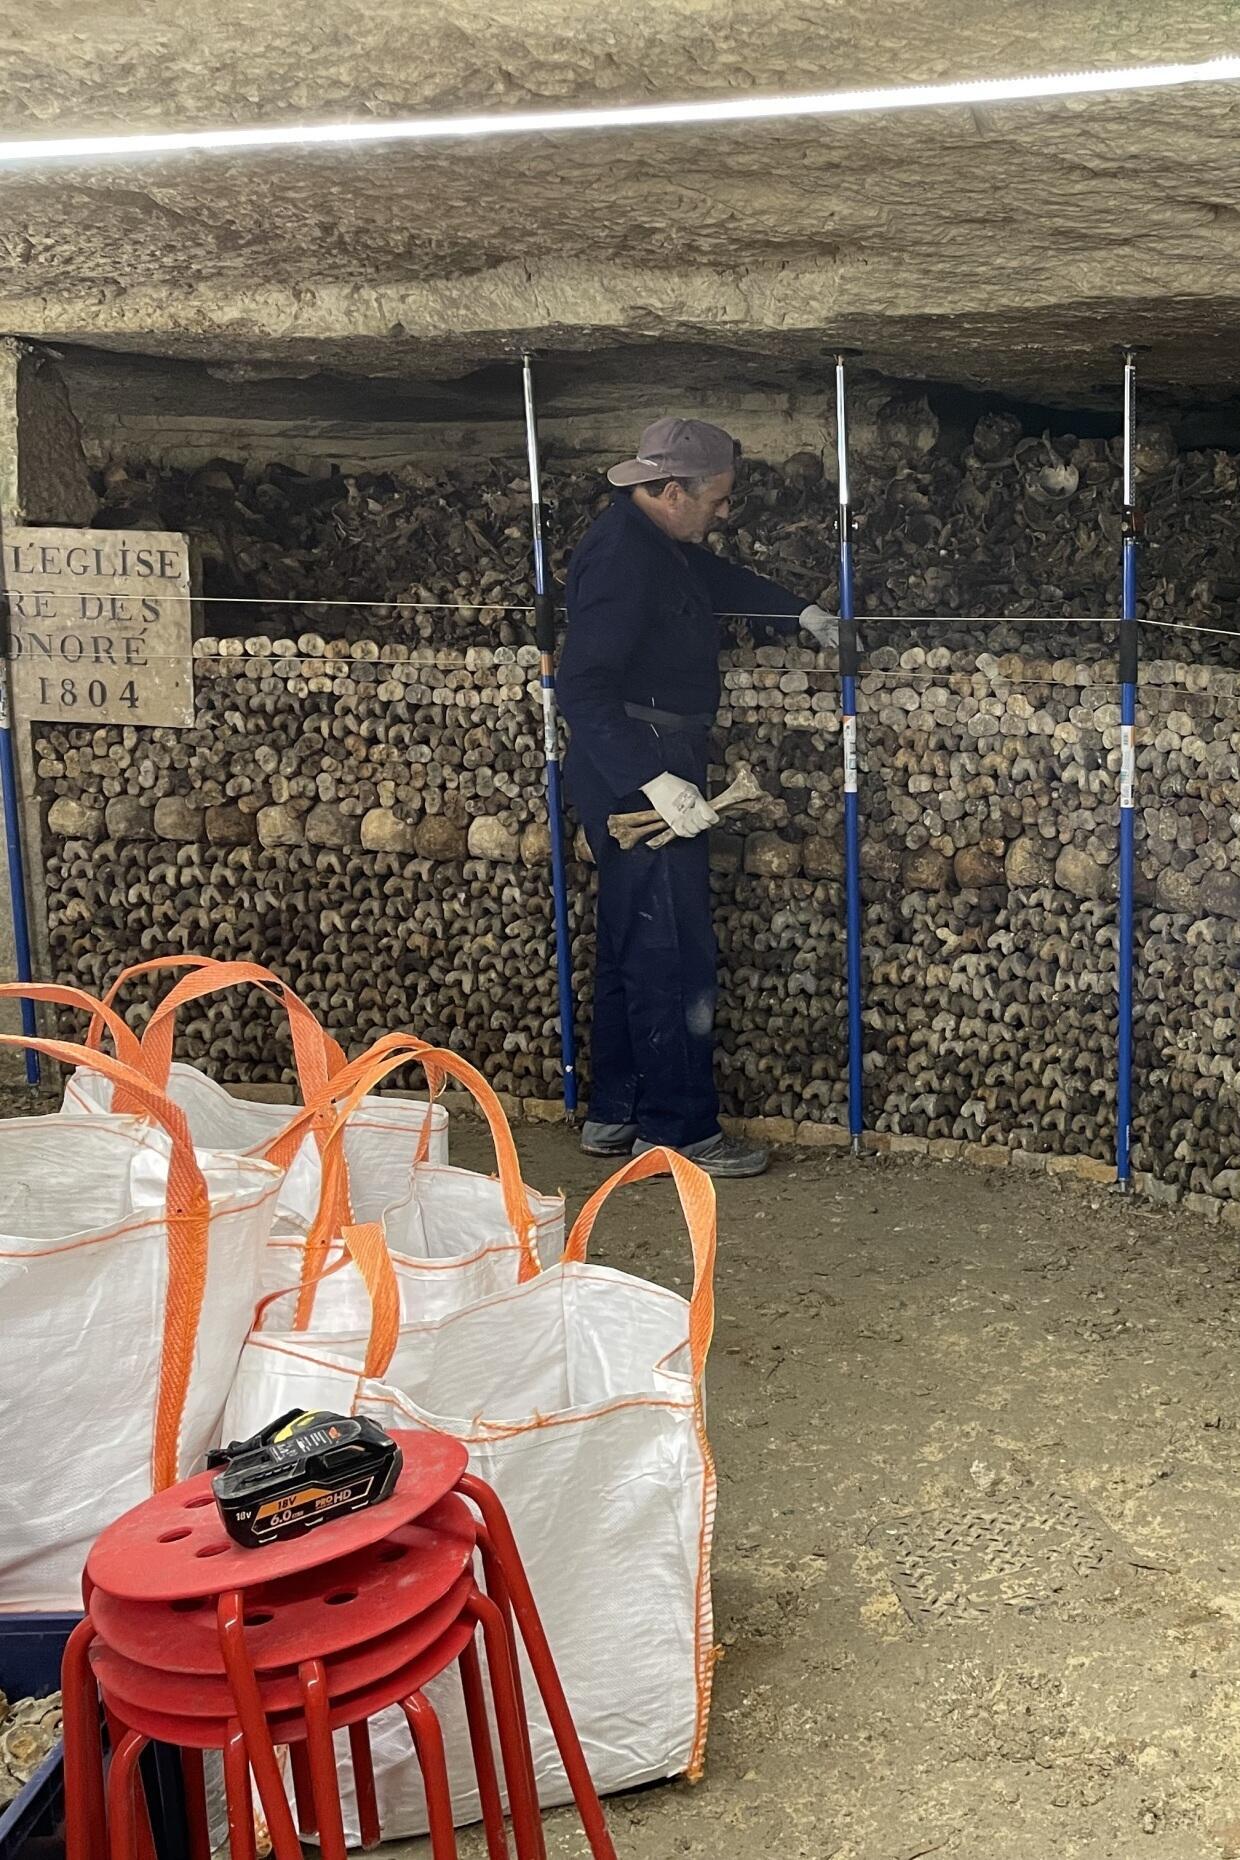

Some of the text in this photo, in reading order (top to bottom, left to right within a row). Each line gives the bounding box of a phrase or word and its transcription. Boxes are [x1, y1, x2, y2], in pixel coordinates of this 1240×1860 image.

[78, 591, 161, 624] DES
[38, 676, 140, 709] 1804
[277, 1495, 297, 1511] 18V
[270, 1510, 292, 1526] 6.0
